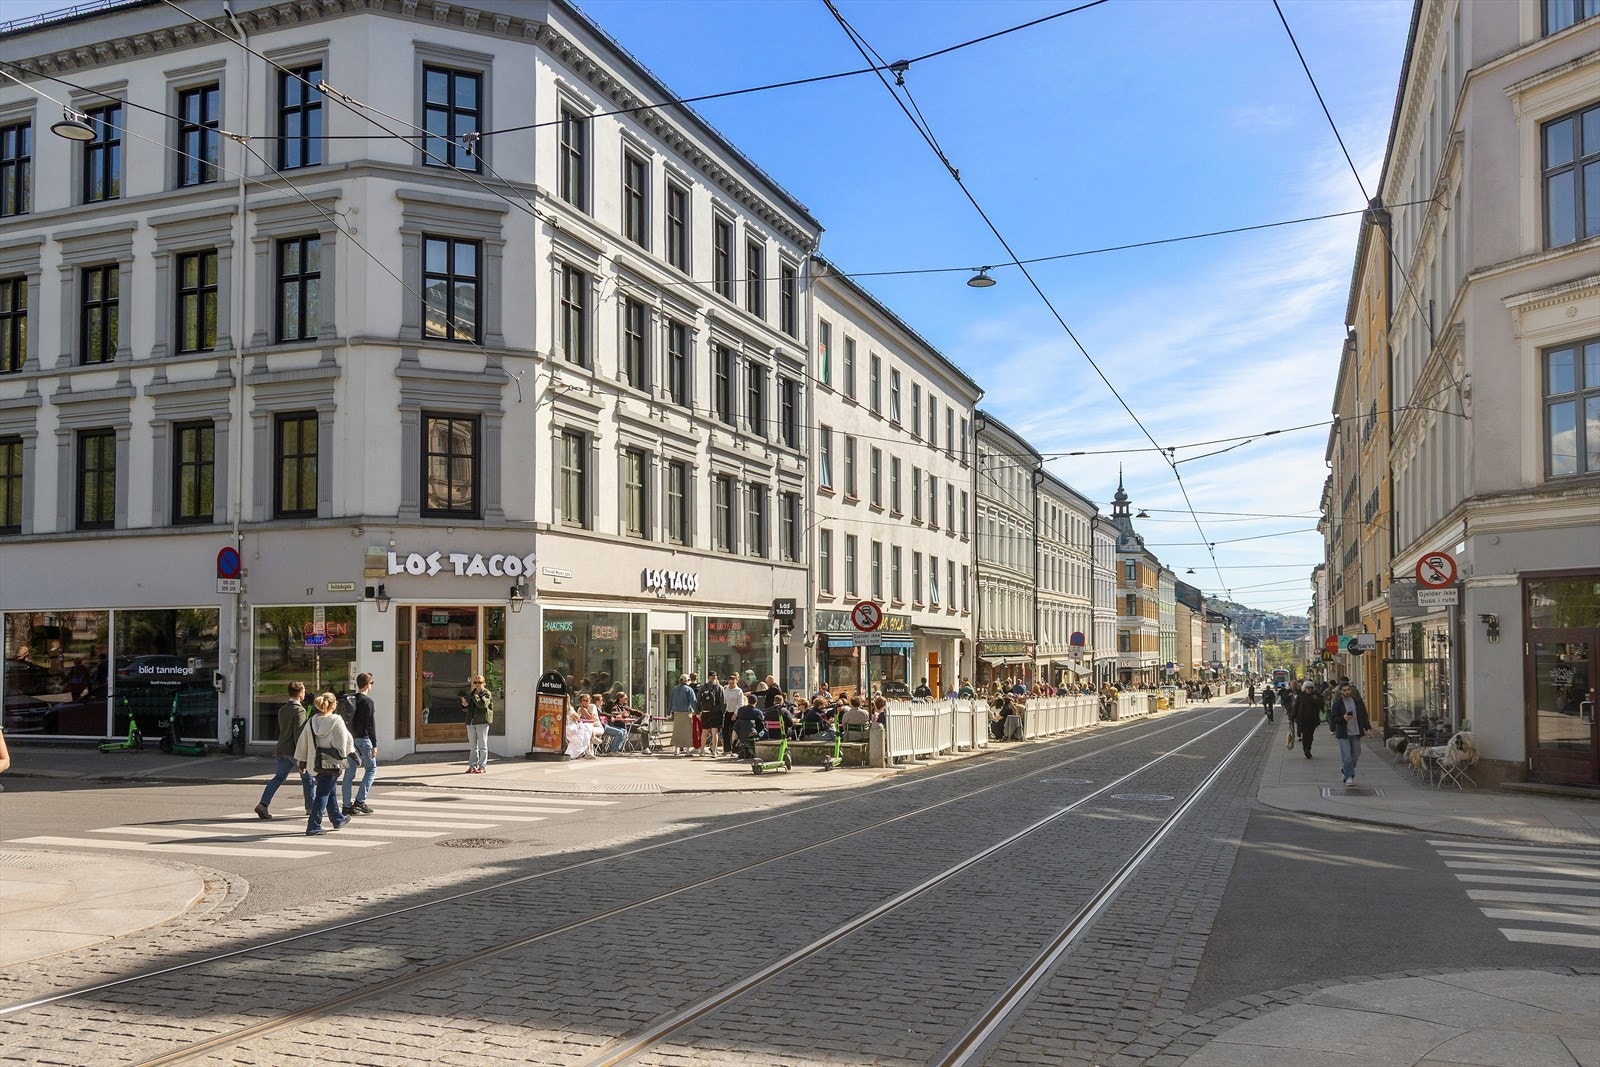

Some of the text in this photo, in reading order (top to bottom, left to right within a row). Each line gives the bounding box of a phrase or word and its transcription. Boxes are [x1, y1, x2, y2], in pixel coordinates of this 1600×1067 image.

[387, 551, 537, 578] LOS TACOS
[646, 567, 699, 592] LOS TACOS
[306, 588, 314, 596] 17
[304, 621, 347, 636] OPEN
[547, 621, 573, 631] NACHOS
[595, 625, 619, 639] OPEN
[138, 665, 194, 676] blid tannlege
